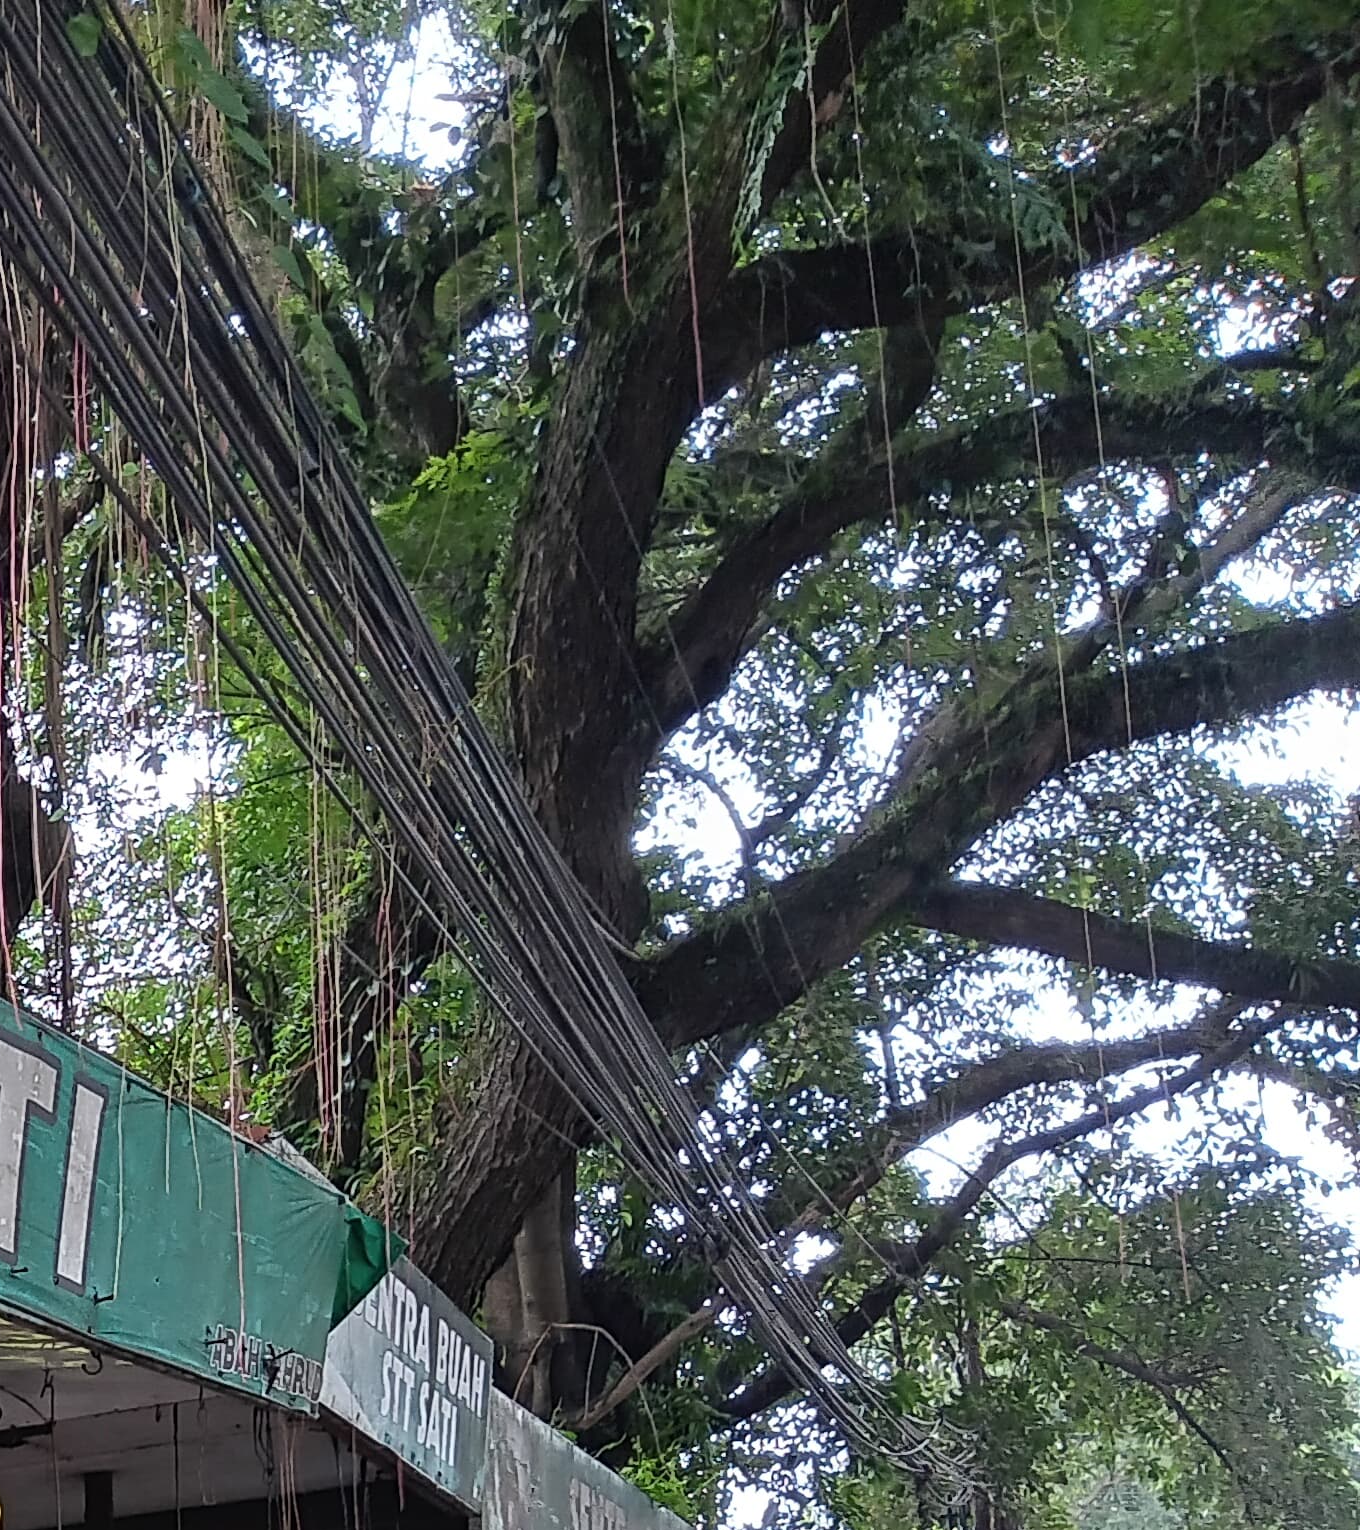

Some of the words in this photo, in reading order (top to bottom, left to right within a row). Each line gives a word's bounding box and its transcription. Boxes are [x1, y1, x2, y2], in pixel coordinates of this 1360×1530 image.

[353, 1272, 430, 1373] ENTRA
[436, 1318, 486, 1418] BUAH
[381, 1350, 416, 1433] STT
[417, 1381, 459, 1467] SATI
